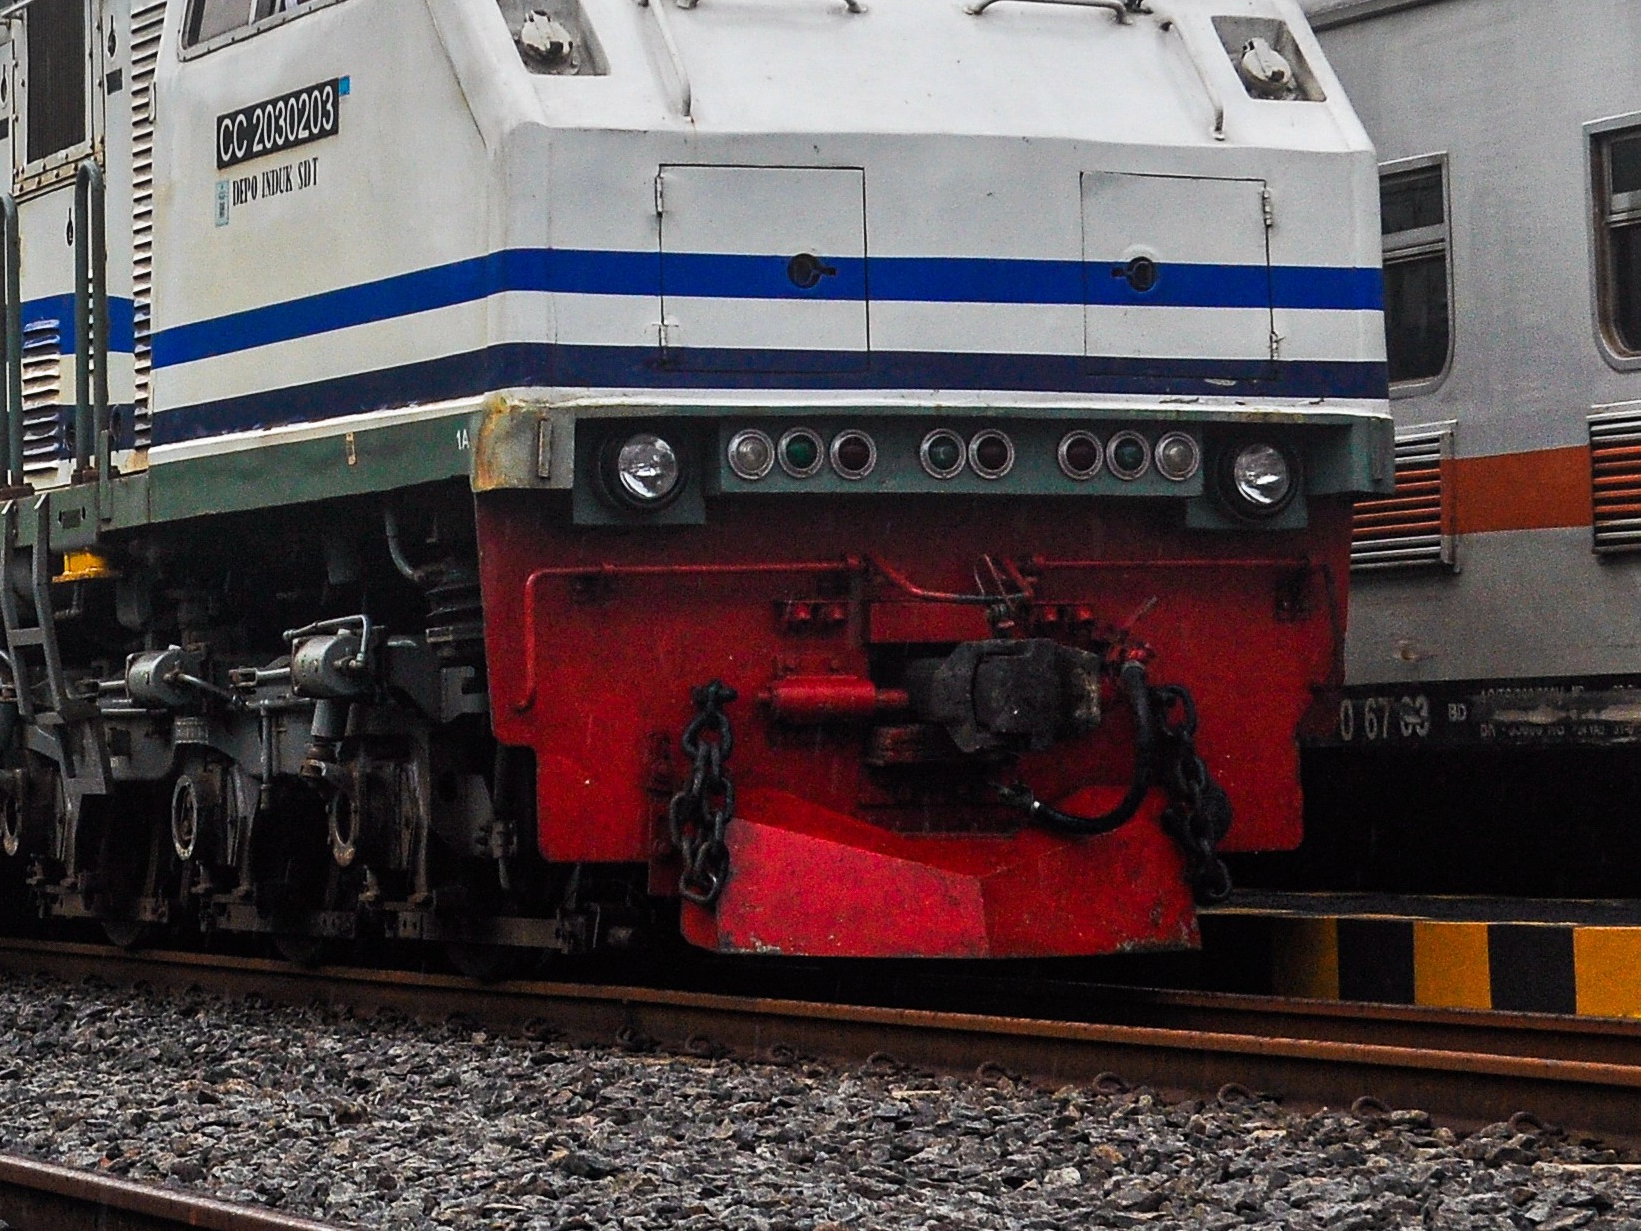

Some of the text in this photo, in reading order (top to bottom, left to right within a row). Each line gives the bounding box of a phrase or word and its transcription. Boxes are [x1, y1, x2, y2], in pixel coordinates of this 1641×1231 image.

[219, 85, 334, 161] CC 2030203
[232, 175, 258, 206] DEPO
[261, 164, 293, 198] INDUK
[456, 428, 470, 450] 1A
